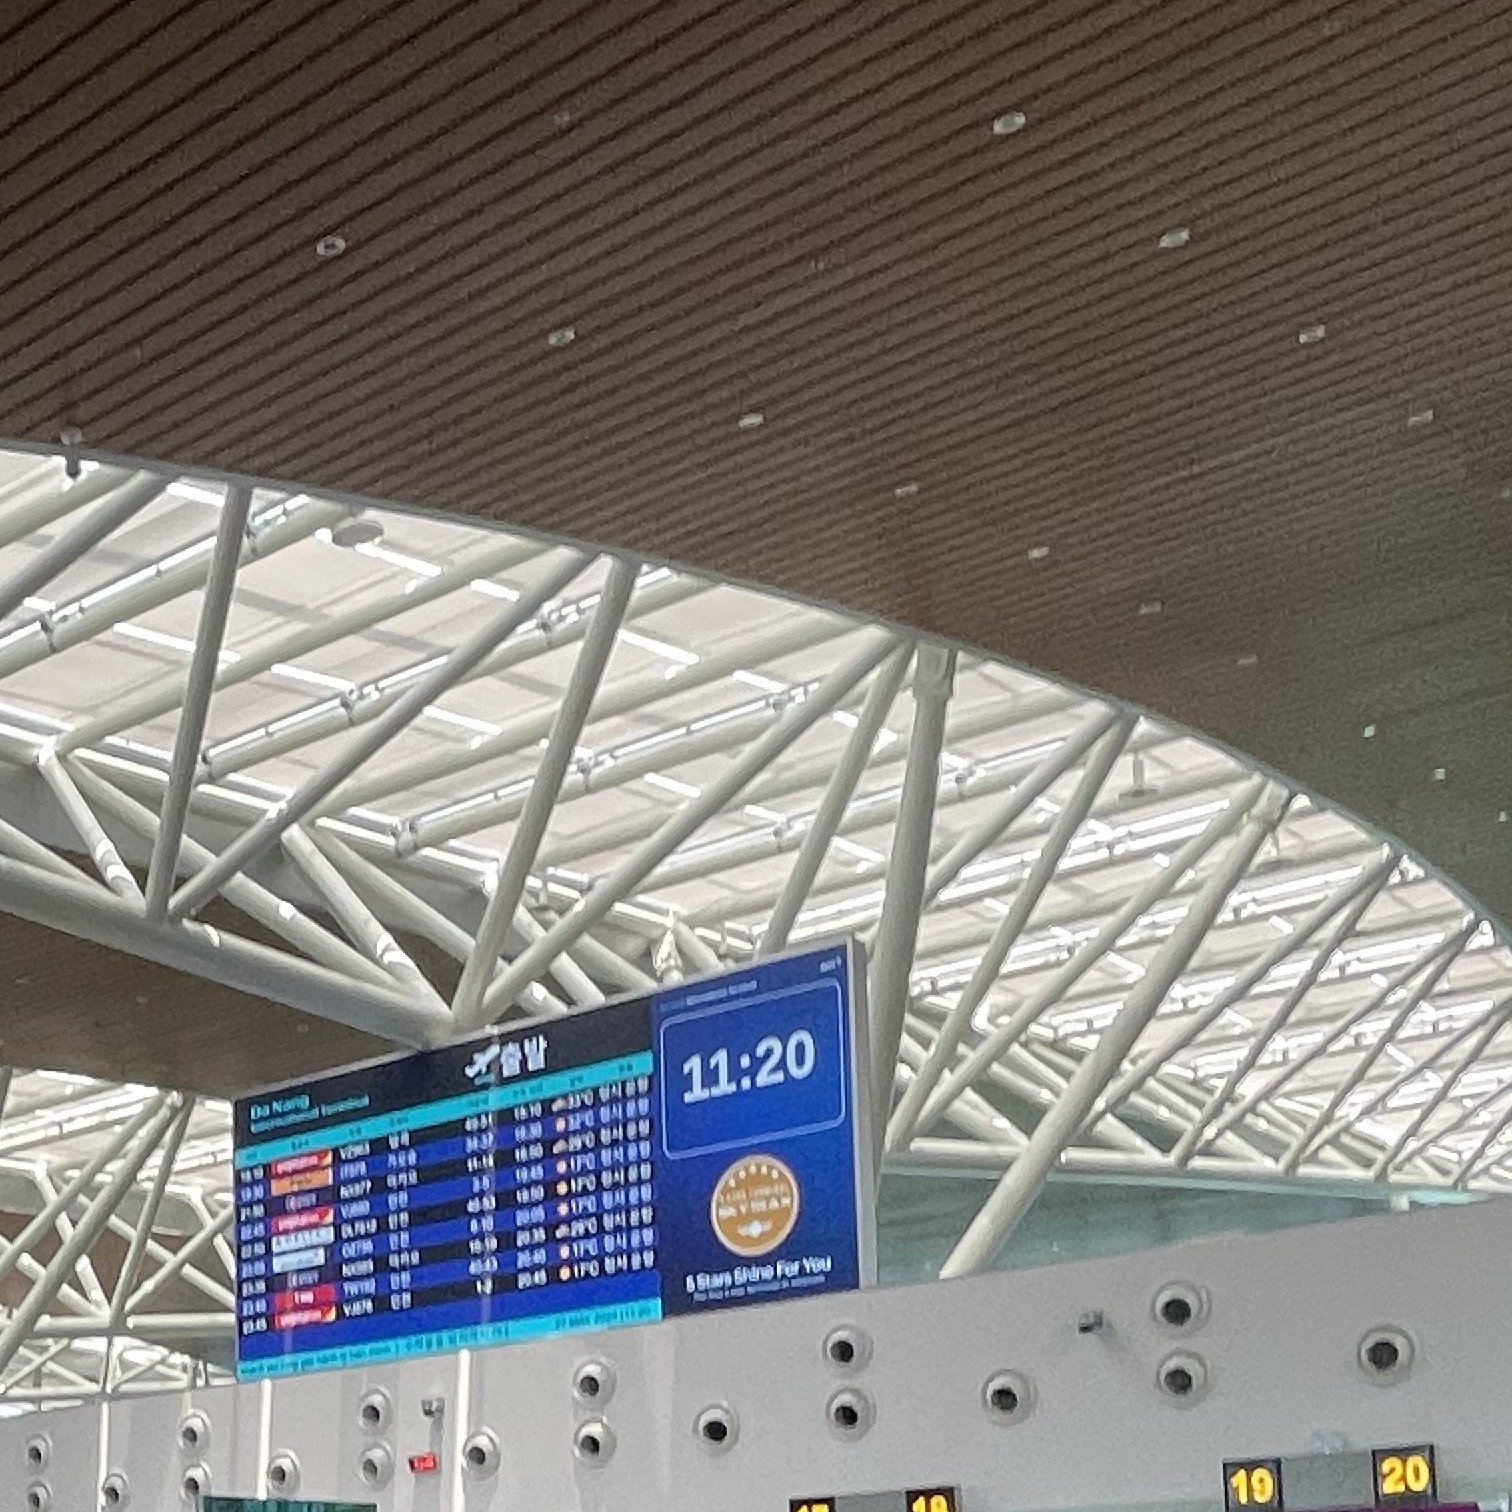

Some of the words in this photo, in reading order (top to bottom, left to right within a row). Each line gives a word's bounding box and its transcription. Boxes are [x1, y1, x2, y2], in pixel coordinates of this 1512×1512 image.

[682, 1028, 816, 1104] 11:20
[776, 1259, 800, 1280] For
[802, 1254, 833, 1274] You
[1229, 1465, 1275, 1507] 19
[1379, 1453, 1431, 1495] 20
